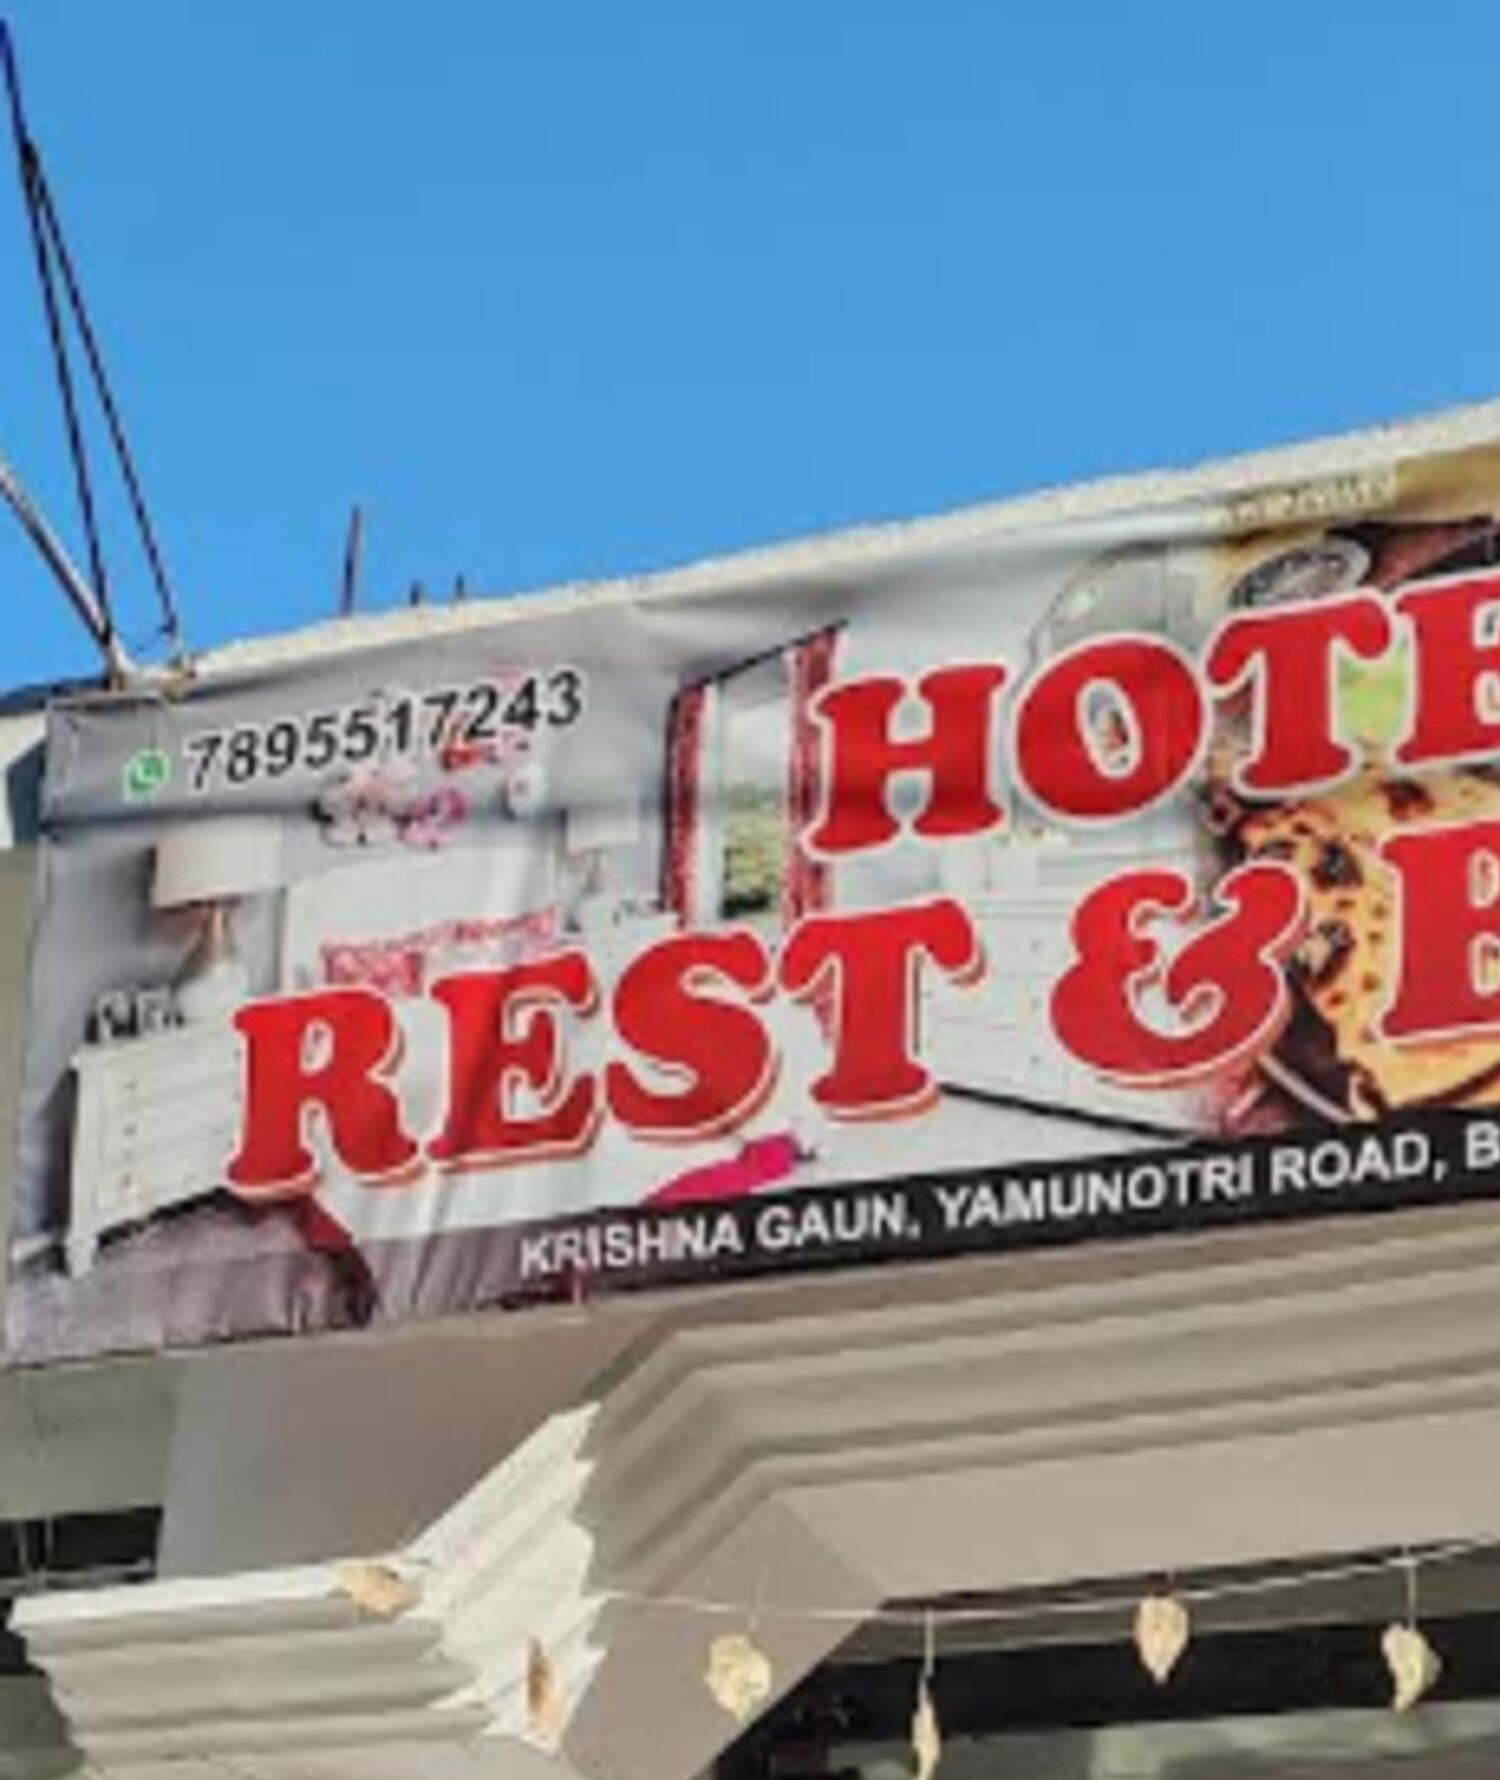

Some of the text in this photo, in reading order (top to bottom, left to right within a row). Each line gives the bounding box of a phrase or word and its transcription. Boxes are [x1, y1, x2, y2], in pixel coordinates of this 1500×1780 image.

[191, 670, 584, 788] 7895517243
[229, 900, 980, 1192] REST
[1048, 865, 1303, 1084] &
[518, 1216, 744, 1277] KRISHNA
[935, 1156, 1254, 1228] YAMUNOTRI
[1269, 1131, 1448, 1194] ROAD,
